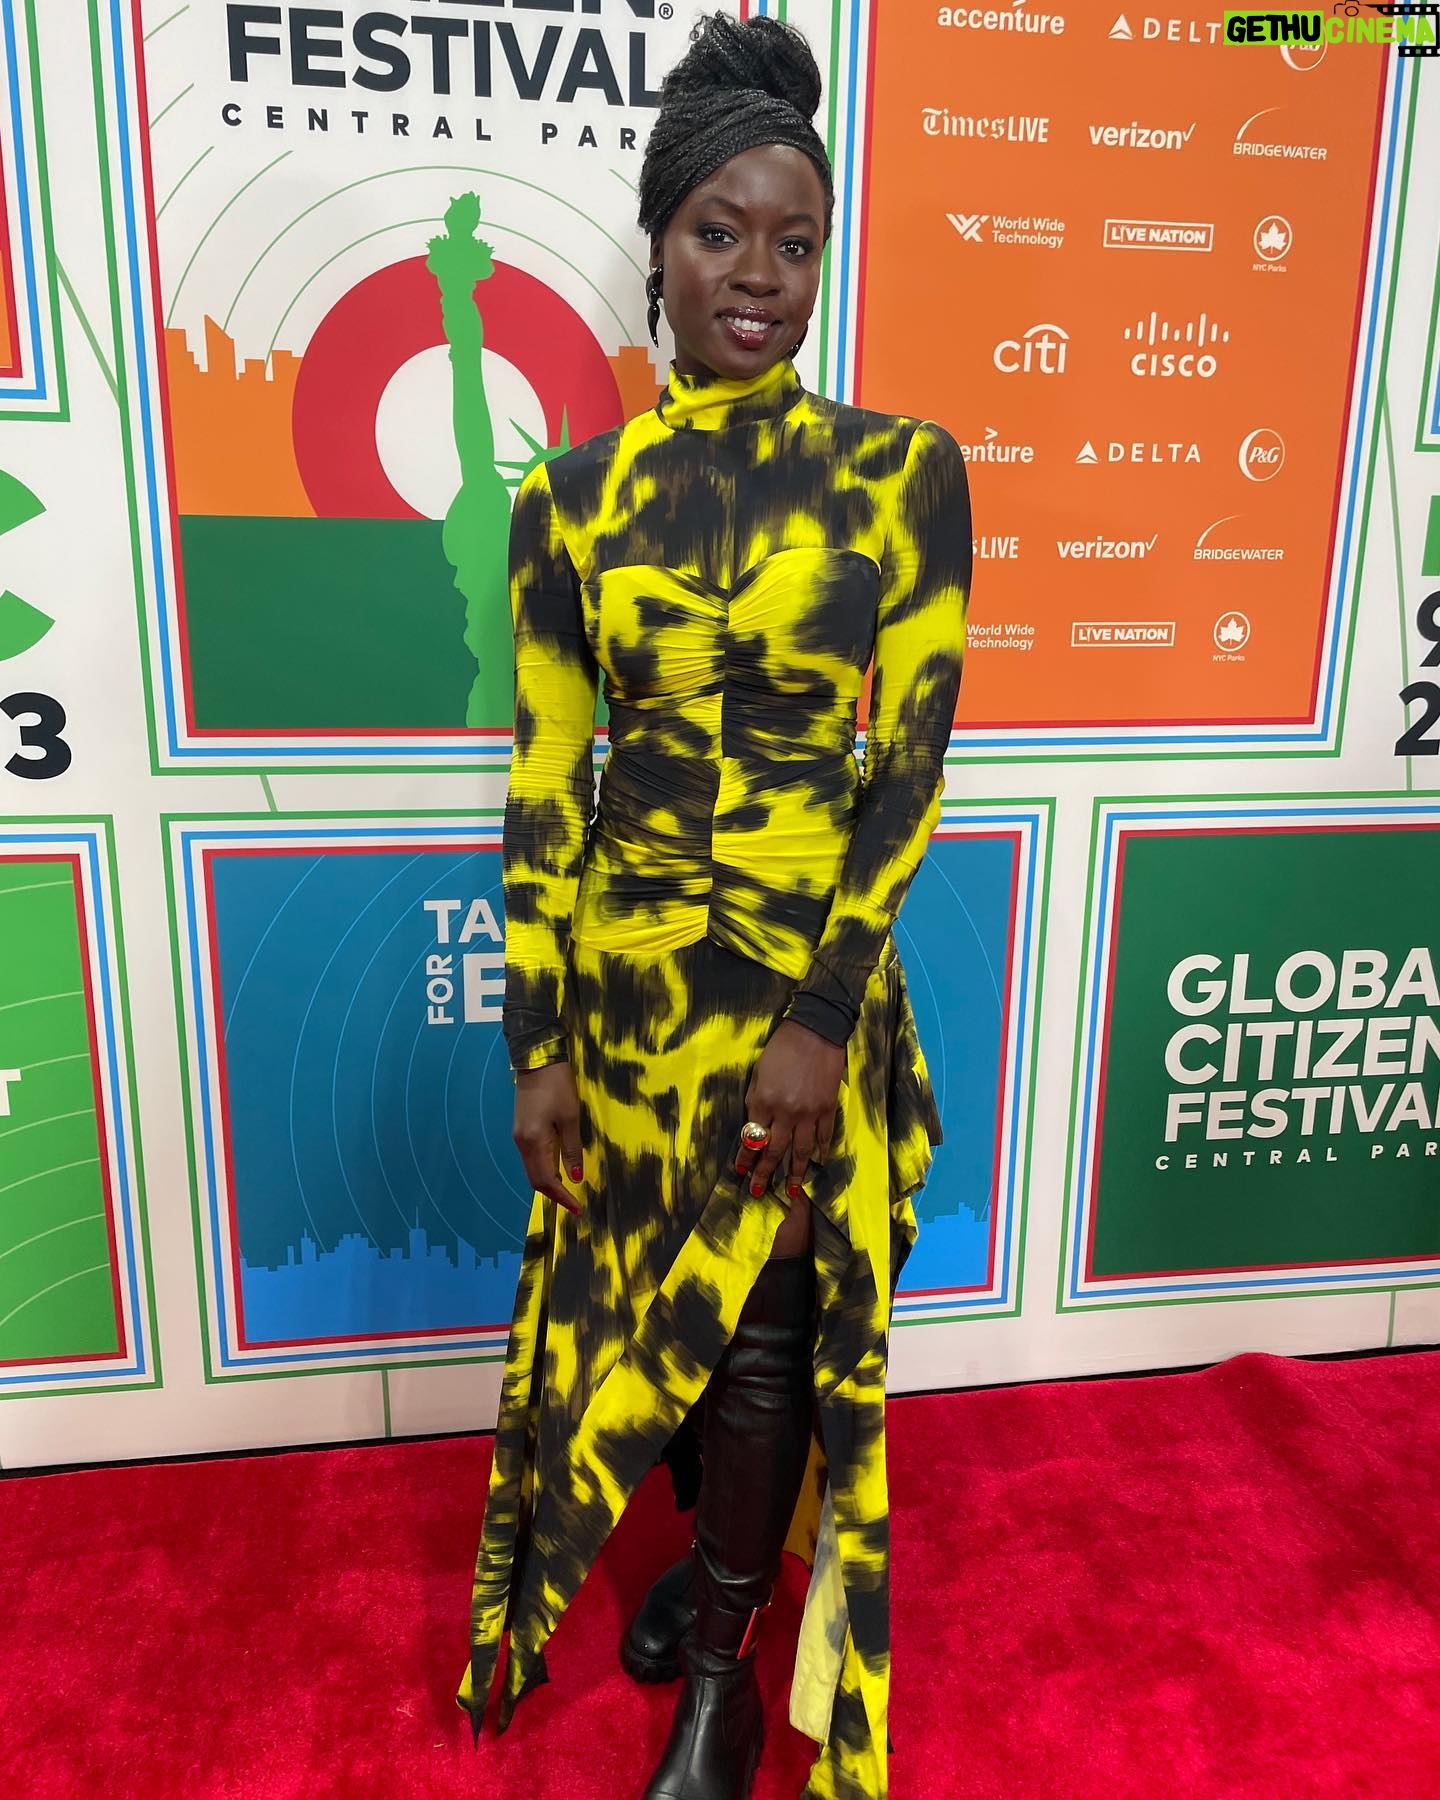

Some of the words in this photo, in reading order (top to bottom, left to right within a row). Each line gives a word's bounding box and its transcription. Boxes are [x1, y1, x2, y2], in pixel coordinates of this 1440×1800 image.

[938, 5, 1065, 36] accenture
[1143, 17, 1222, 45] DELT
[226, 3, 663, 109] FESTIVAL
[221, 103, 492, 142] CENTRAL
[541, 122, 637, 151] PAR
[1088, 121, 1182, 150] verizon
[1232, 142, 1328, 161] BRIDGEWATER
[992, 215, 1030, 231] World
[1032, 217, 1065, 232] Wide
[1110, 225, 1146, 243] LIVE
[1149, 227, 1206, 245] NATION
[992, 230, 1064, 249] Technology
[1252, 263, 1267, 272] NYC
[1267, 264, 1287, 273] Parks
[993, 331, 1067, 374] citi
[1130, 353, 1218, 378] CISCO
[960, 440, 1034, 464] enture
[1107, 442, 1201, 463] DELTA
[1248, 446, 1281, 464] P&G
[972, 536, 1020, 559] LIVE
[1056, 535, 1145, 560] verizon
[1193, 548, 1285, 561] BRIDGEWATER
[966, 624, 1003, 636] World
[1005, 624, 1035, 636] Wide
[1079, 627, 1111, 642] LIVE
[1114, 628, 1168, 642] NATION
[966, 636, 1034, 651] Technology
[1212, 654, 1226, 662] NYC
[1227, 654, 1245, 662] Parks
[423, 898, 504, 944] TA
[426, 953, 454, 1025] FOR
[1167, 947, 1440, 1017] GLOBA
[1164, 1082, 1440, 1143] FESTIVA
[1155, 1148, 1338, 1171] CENTRAL
[1371, 1141, 1438, 1159] PAR
